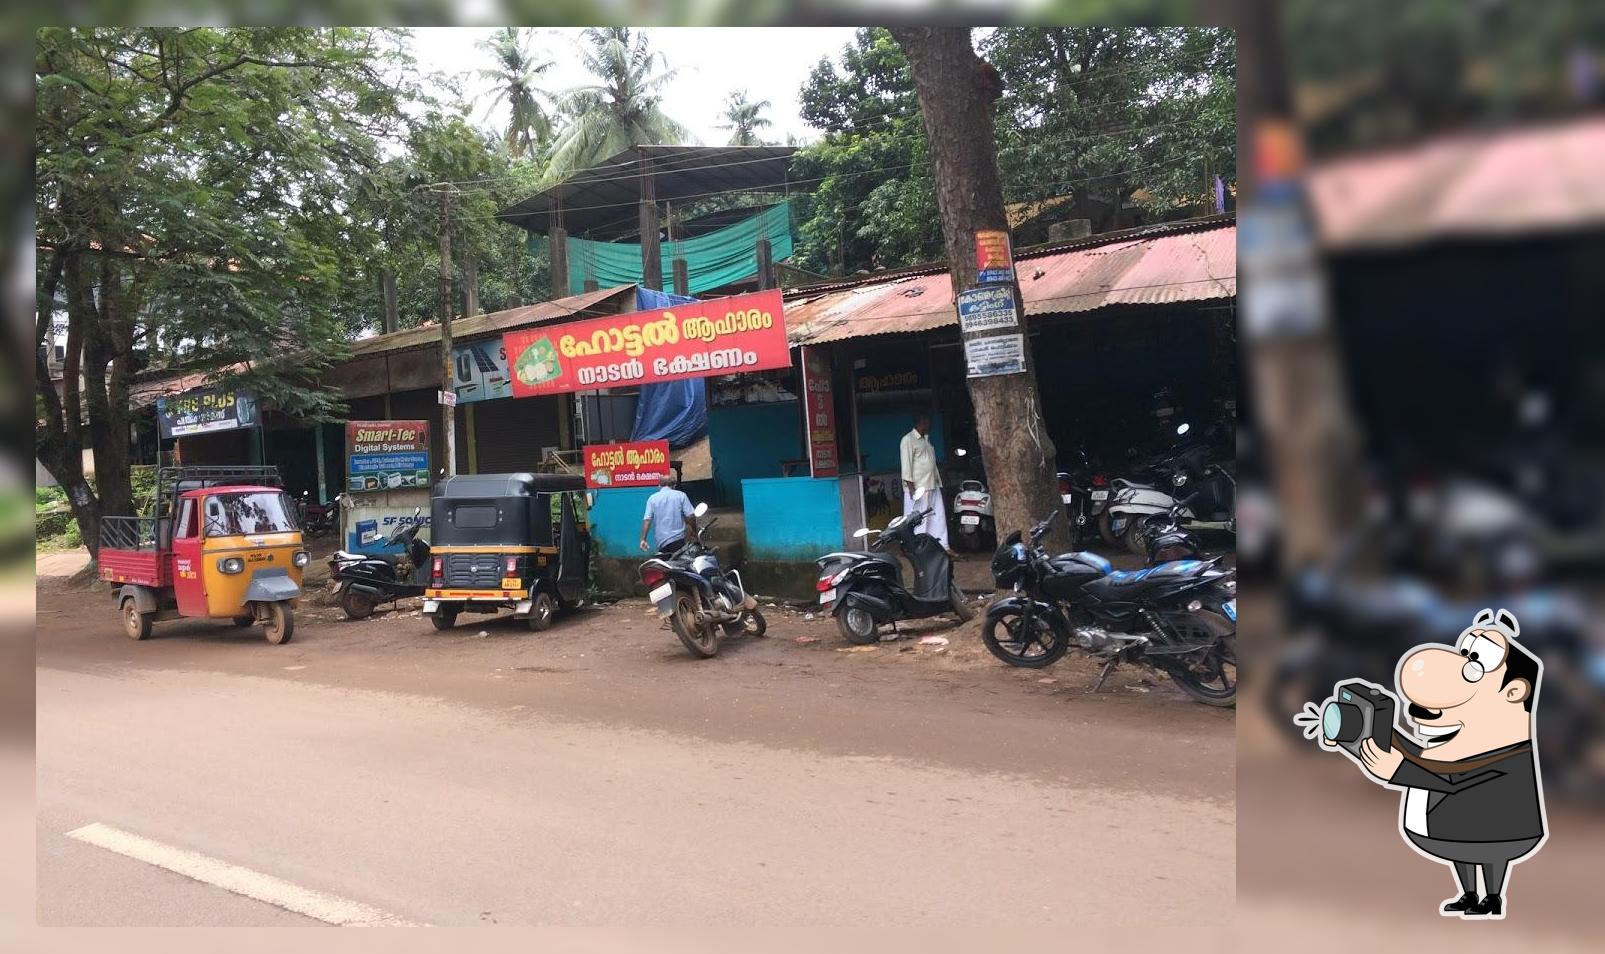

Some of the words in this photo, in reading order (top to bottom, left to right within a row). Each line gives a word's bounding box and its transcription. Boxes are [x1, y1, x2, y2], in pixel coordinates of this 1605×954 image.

[559, 312, 679, 357] ഹോട്ടൽ
[682, 309, 772, 342] ആഹാരം
[578, 358, 644, 385] നാടൻ
[653, 347, 758, 376] ഭക്ഷണം
[355, 428, 416, 442] Smart-Tec
[354, 443, 381, 453] Digital
[382, 443, 415, 452] Systems
[591, 446, 625, 470] ഹോട്ടൽ
[626, 448, 665, 469] ആഹാരം
[614, 471, 636, 481] നാടൻ
[383, 516, 397, 525] SF
